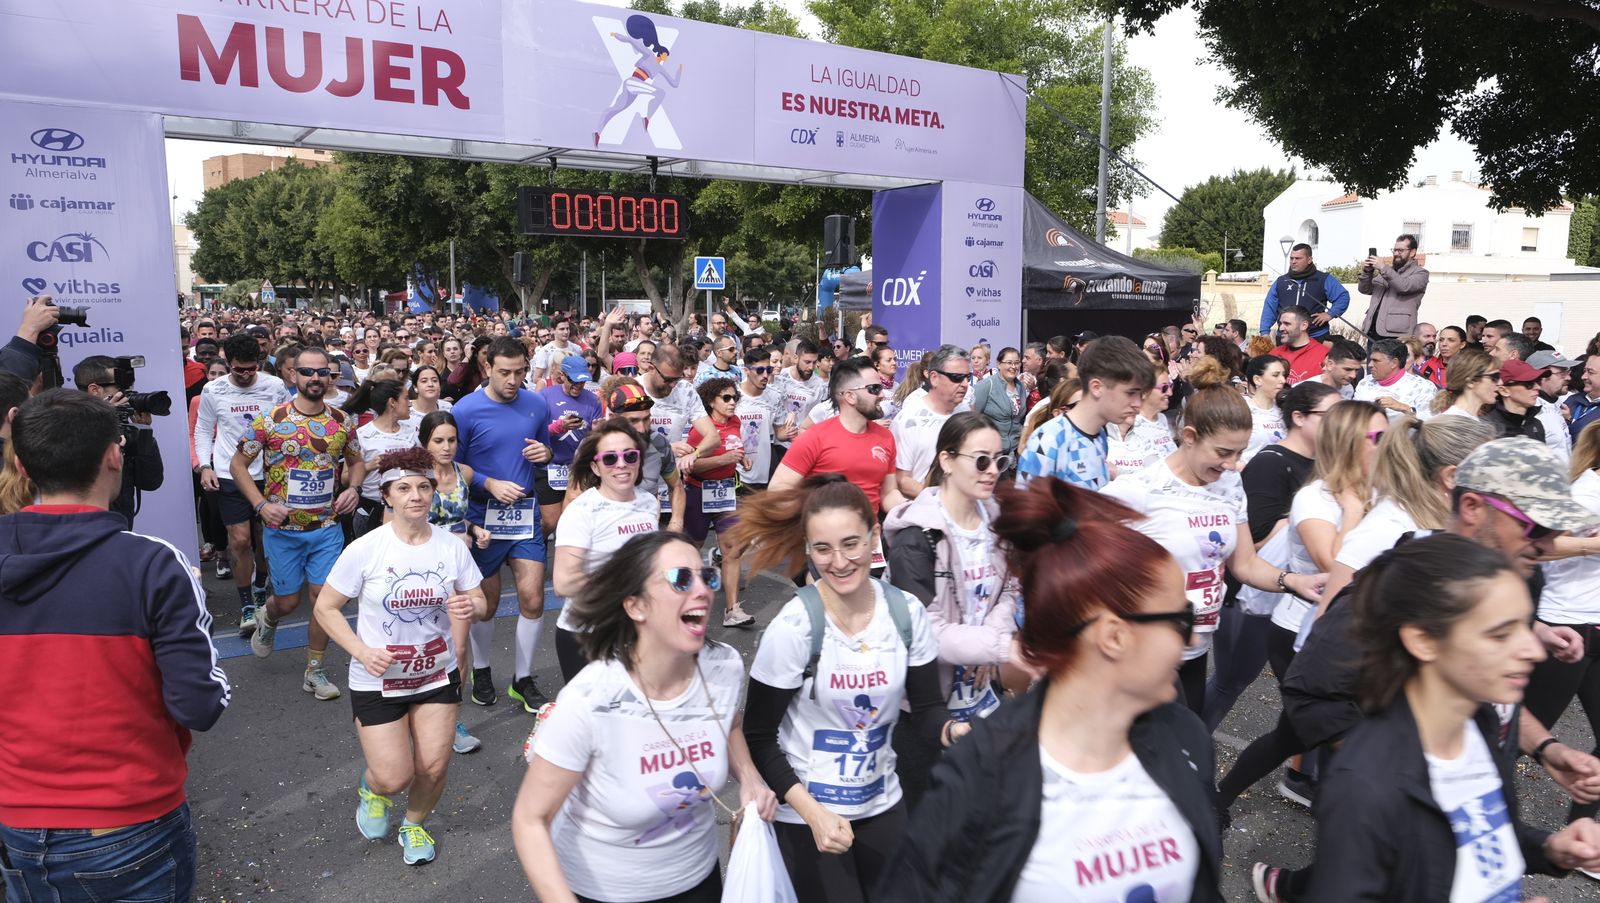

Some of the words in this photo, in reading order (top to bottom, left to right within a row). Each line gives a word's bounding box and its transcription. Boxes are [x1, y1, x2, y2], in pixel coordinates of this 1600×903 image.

[367, 0, 406, 28] DE
[417, 6, 453, 34] LA
[176, 13, 471, 110] MUJER
[811, 64, 832, 84] LA
[837, 68, 921, 97] IGUALDAD
[781, 91, 806, 112] ES
[809, 95, 892, 123] NUESTRA
[895, 107, 945, 130] META.
[790, 127, 820, 145] CDX
[11, 153, 106, 168] HYUNDAI
[25, 167, 97, 181] Almerialva
[39, 196, 116, 212] cajamar
[551, 192, 679, 234] 00:00:00
[967, 212, 1003, 222] HYUNDAI
[976, 238, 1004, 248] cajamar
[26, 240, 93, 263] CASI
[968, 264, 994, 279] CASI
[53, 279, 121, 294] vithas
[881, 270, 928, 306] CDX
[976, 288, 1002, 297] vithas
[970, 317, 1001, 329] aqualia
[59, 327, 124, 348] qualia
[894, 348, 923, 361] ALMERÍ
[787, 393, 807, 402] MUJER
[230, 405, 260, 413] MUJER
[1115, 459, 1144, 467] MUJER
[299, 481, 326, 492] 299
[711, 488, 727, 498] 162
[496, 510, 522, 521] 248
[1187, 514, 1230, 528] MUJER
[617, 522, 653, 535] MUJER
[404, 588, 434, 599] MINI
[390, 597, 444, 609] RUNNER
[400, 656, 436, 673] 788
[830, 670, 888, 690] MUJER
[640, 740, 716, 775] MUJER
[834, 751, 878, 777] 174
[1074, 836, 1183, 888] MUJER
